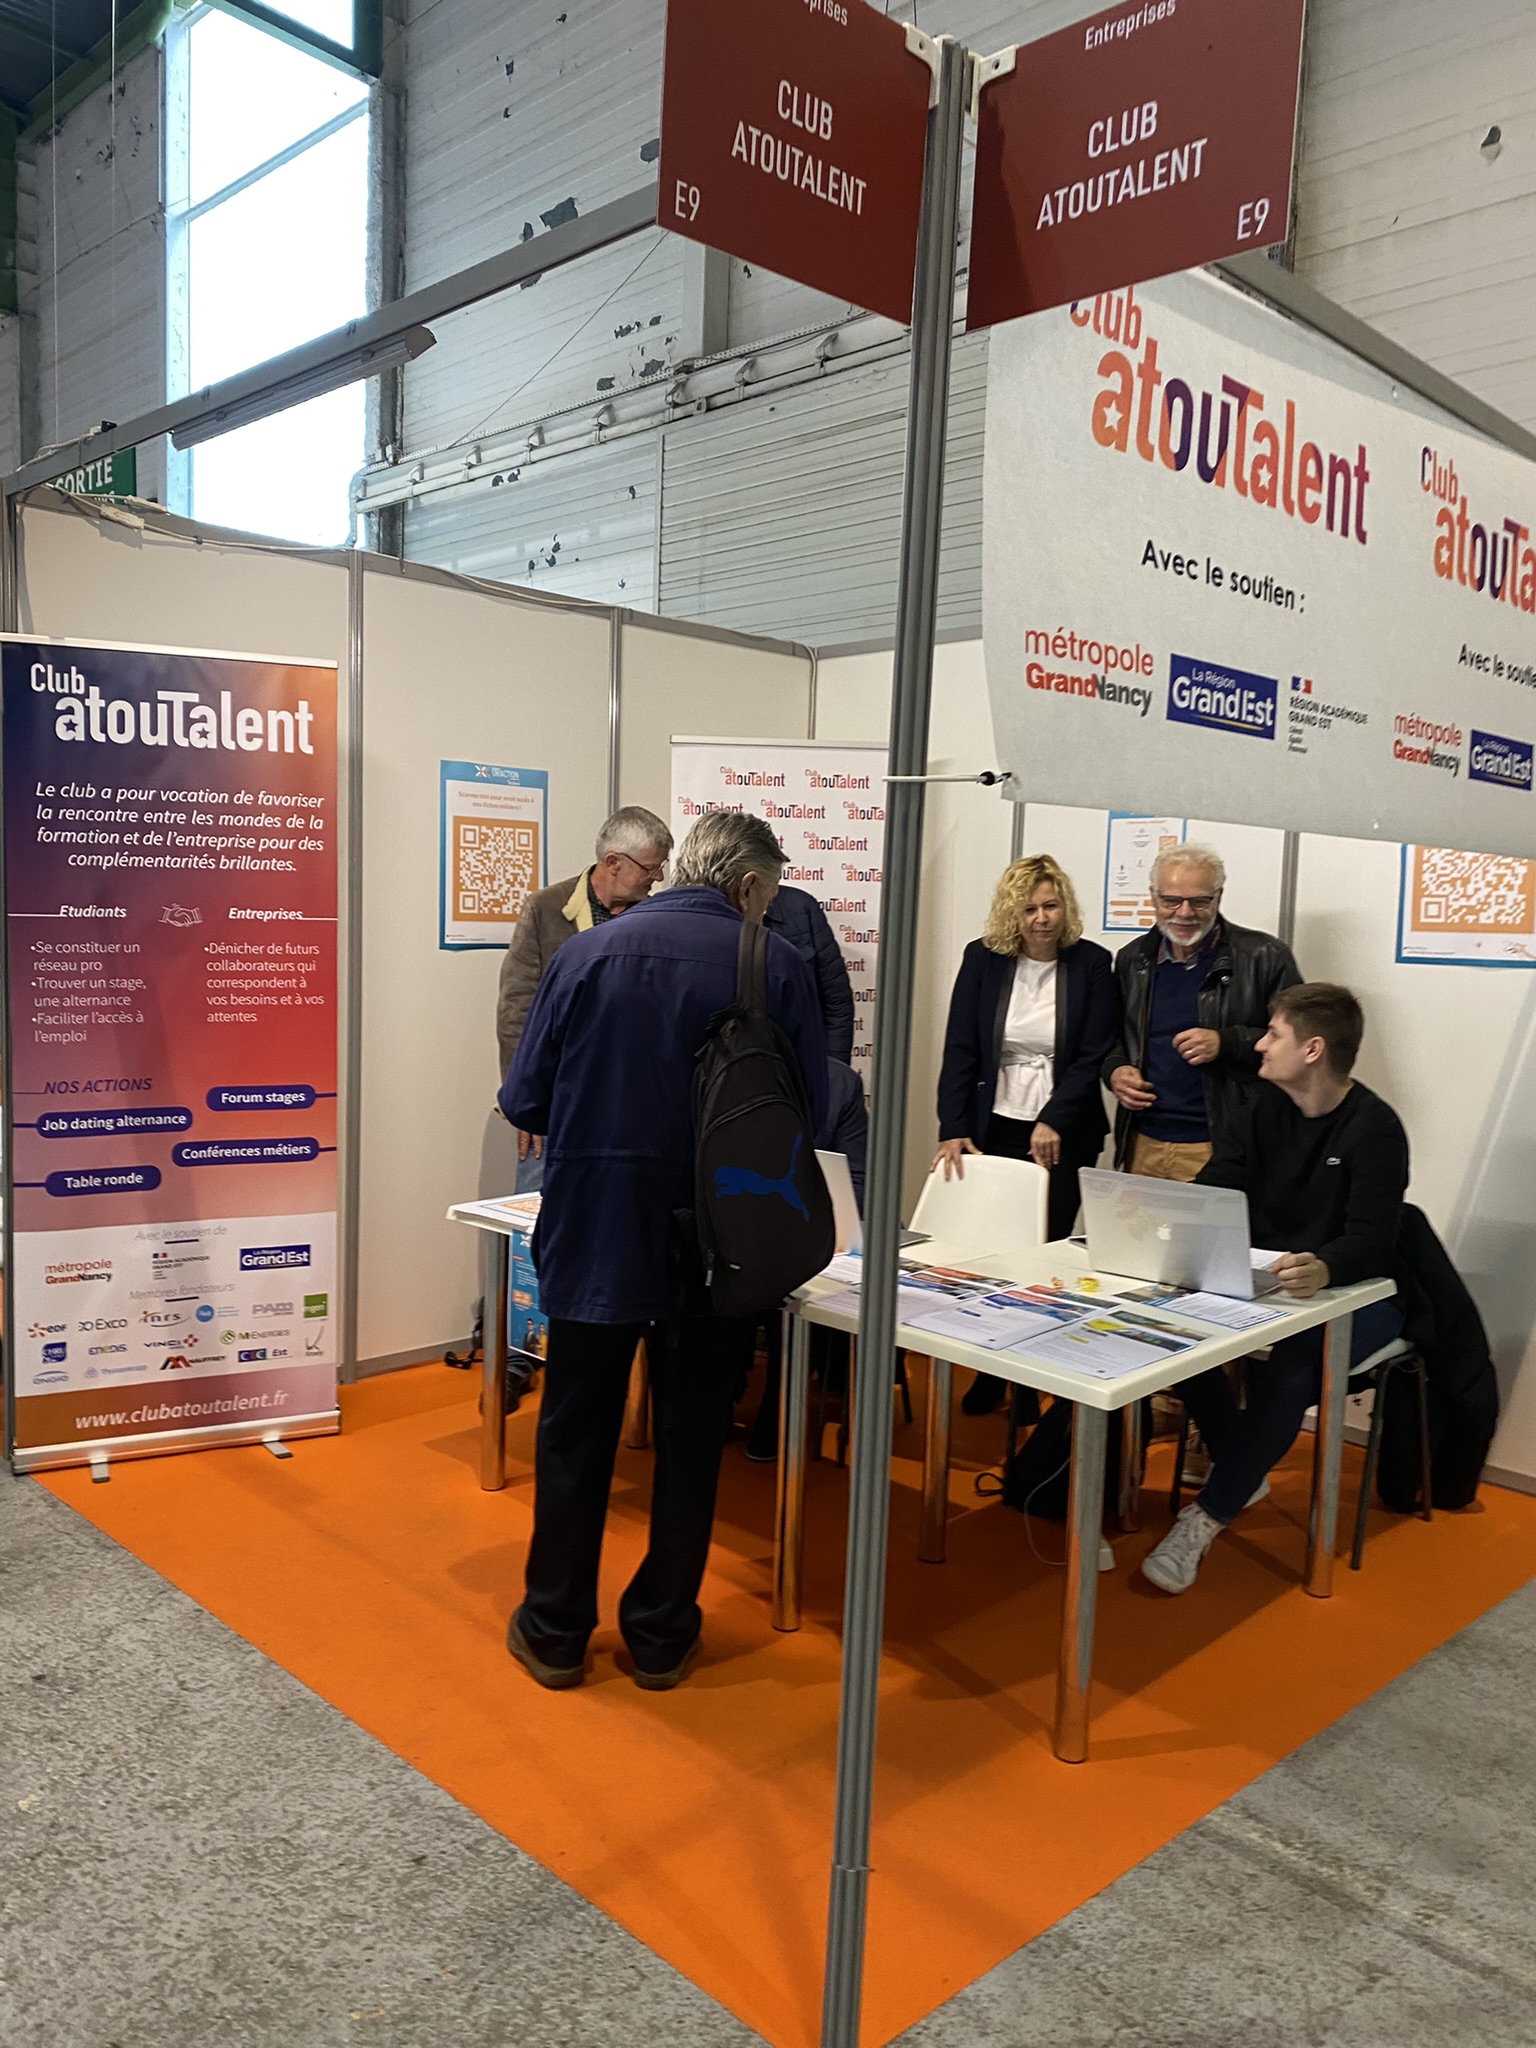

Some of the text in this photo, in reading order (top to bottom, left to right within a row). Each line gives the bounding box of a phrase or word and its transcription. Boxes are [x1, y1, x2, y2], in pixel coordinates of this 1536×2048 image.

[1085, 0, 1176, 50] Entreprises
[777, 79, 833, 141] CLUB
[1088, 100, 1158, 159] CLUB
[731, 120, 867, 215] ATOUTALENT
[1036, 138, 1208, 231] ATOUTALENT
[675, 179, 700, 221] E9
[1236, 197, 1270, 242] E9
[1091, 335, 1369, 545] atouTalent
[1421, 445, 1458, 506] Club
[1141, 539, 1198, 580] Avec
[1205, 557, 1223, 587] le
[1230, 571, 1295, 610] soutien
[1025, 626, 1154, 676] métropole
[1458, 643, 1491, 673] Avec
[1493, 654, 1504, 677] le
[30, 662, 85, 694] Club
[1192, 667, 1236, 690] La Région
[1025, 662, 1153, 717] GrandNancy
[55, 686, 313, 754] atouTalent
[1394, 711, 1462, 747] métropole
[720, 766, 733, 775] Club
[805, 769, 818, 777] Club
[725, 772, 785, 787] atouTalent
[810, 774, 869, 789] atouTalent
[35, 782, 324, 809] Le club a pour vocation de favoriser
[678, 796, 691, 804] Club
[761, 799, 774, 807] Club
[766, 804, 825, 819] atouTalent
[843, 801, 855, 809] Club
[36, 804, 323, 830] la rencontre entre les mondes de la
[36, 827, 324, 852] formation et de l’entreprise pour des
[803, 832, 816, 840] Club
[808, 836, 868, 851] atouTalent
[68, 851, 297, 872] complémentarités brillantes.
[841, 863, 854, 871] Club
[59, 904, 127, 918] Etudiants
[228, 907, 303, 922] Entreprises
[36, 941, 140, 953] Se constituer un
[209, 942, 320, 955] Dénicher de futurs
[33, 958, 102, 973] réseau pro
[206, 959, 316, 974] collaborateurs qui
[36, 977, 147, 991] Trouver un stage,
[206, 976, 307, 991] correspondent à
[34, 994, 131, 1007] une alternance
[206, 993, 325, 1005] vos besoins et à vos
[37, 1012, 89, 1025] Faciliter
[135, 1010, 144, 1023] à
[207, 1012, 258, 1023] attentes
[44, 1078, 153, 1095] NOS ACTIONS
[221, 1090, 306, 1106] Forum stages
[41, 1113, 187, 1132] Job dating alternance
[182, 1143, 311, 1160] Conférences métiers
[64, 1173, 143, 1189] Table ronde
[45, 1258, 112, 1274] métropole
[45, 1272, 112, 1284] GrandNancy
[76, 1390, 289, 1429] www.clubatoutalent.fr
